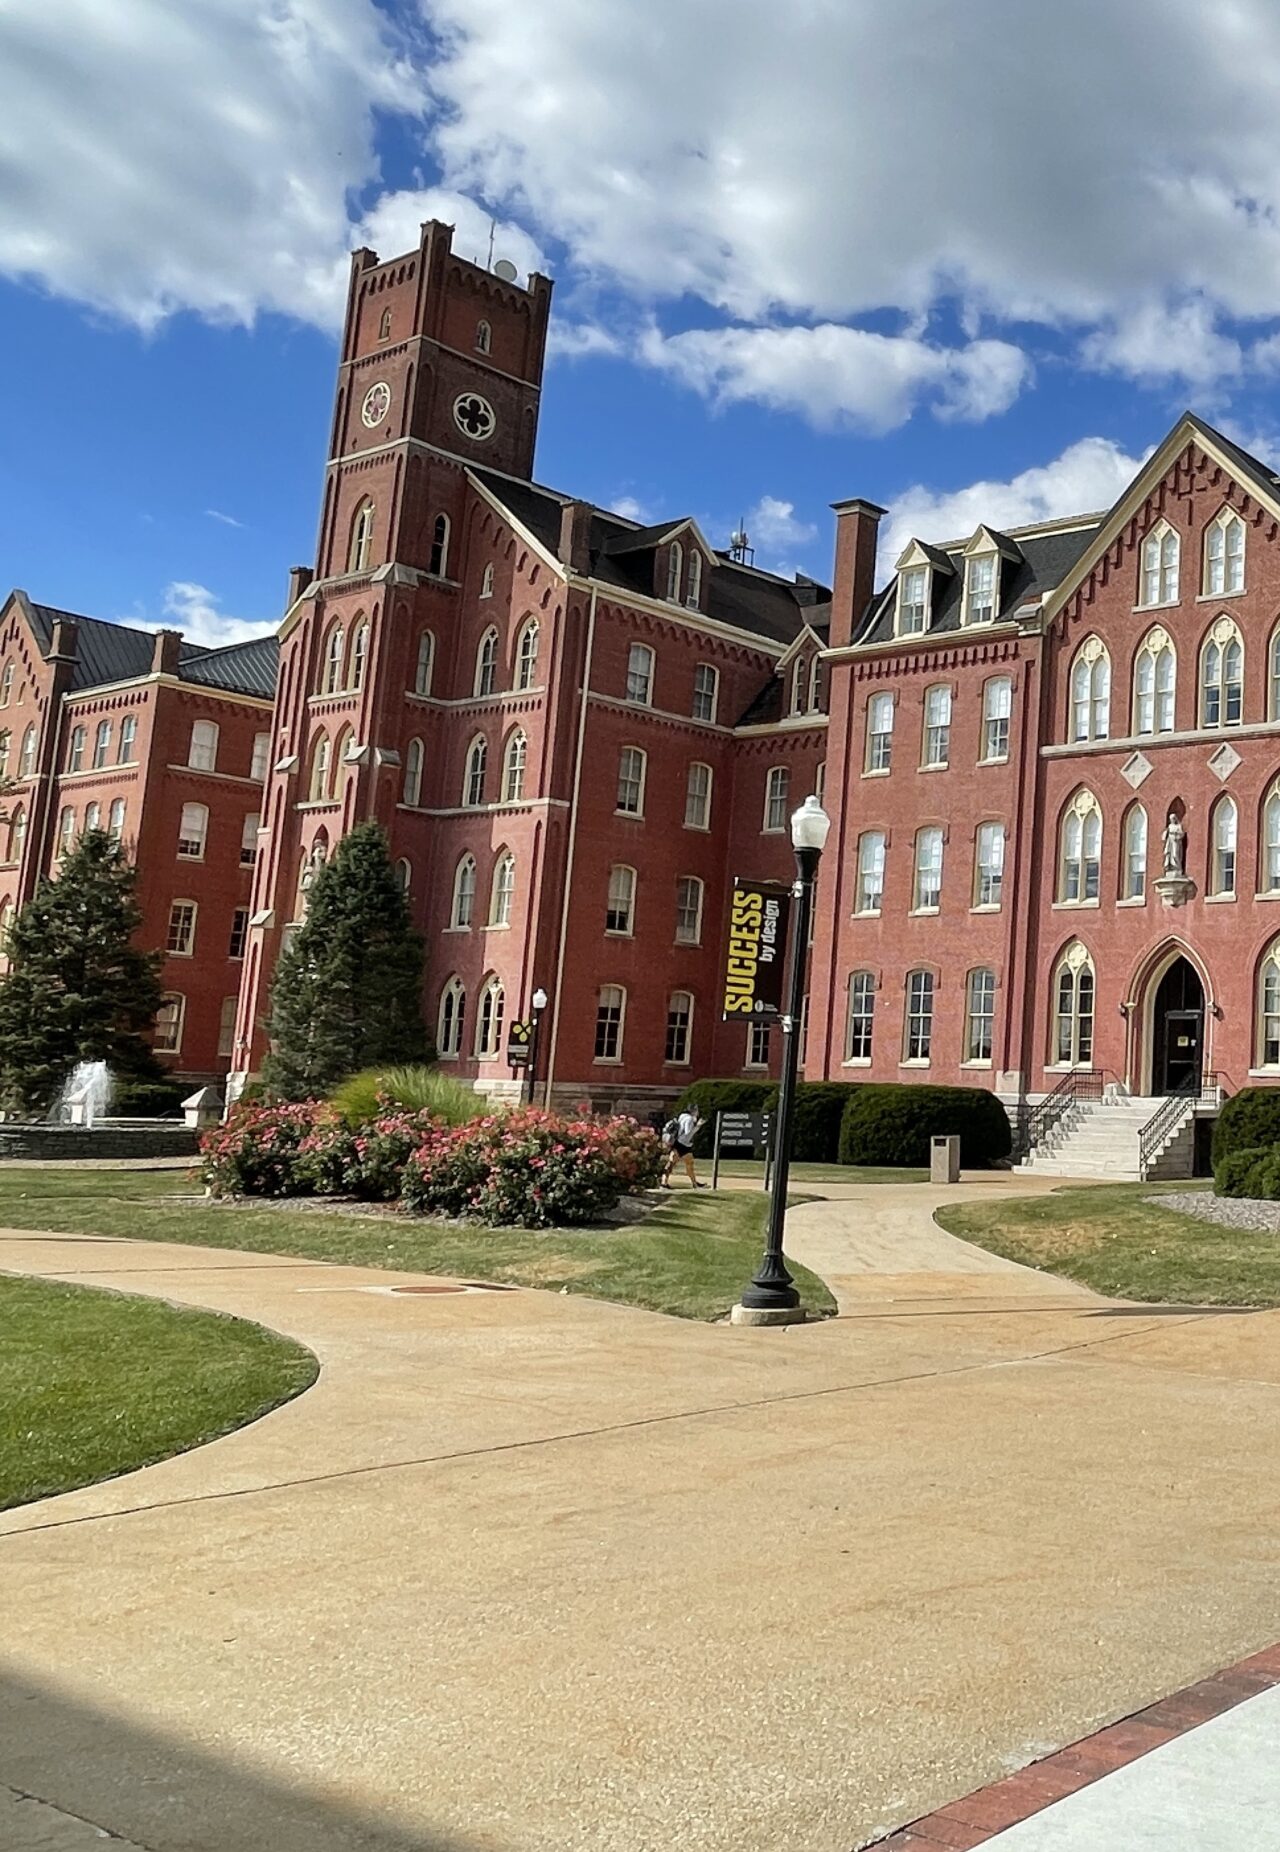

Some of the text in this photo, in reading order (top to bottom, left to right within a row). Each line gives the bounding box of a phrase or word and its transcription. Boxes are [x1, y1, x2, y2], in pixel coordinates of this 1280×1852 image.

[725, 890, 762, 1012] SUCCESS
[758, 899, 780, 963] by design
